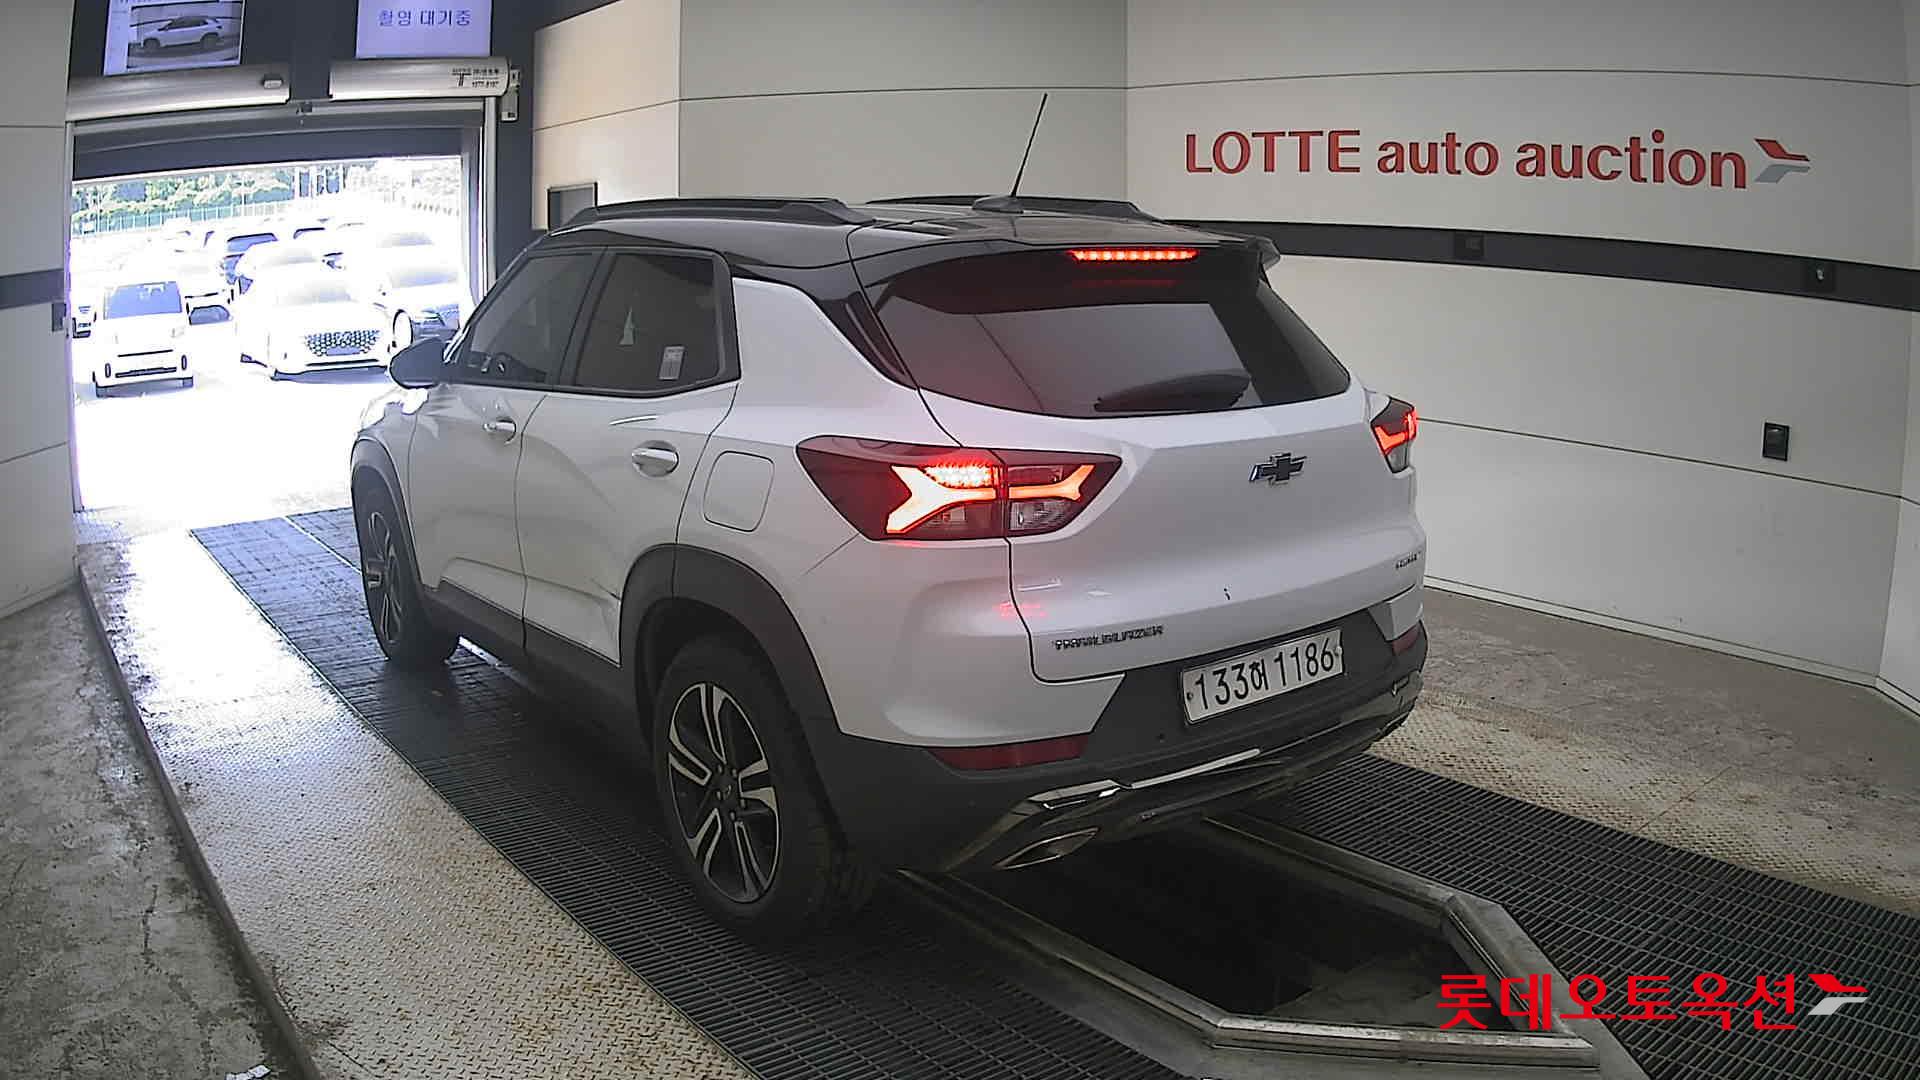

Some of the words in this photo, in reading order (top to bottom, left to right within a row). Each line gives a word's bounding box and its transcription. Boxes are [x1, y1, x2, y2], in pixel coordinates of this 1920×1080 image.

[420, 9, 471, 26] 대기중
[1186, 129, 1361, 174] LOTTE
[1378, 132, 1498, 176] auto
[1516, 129, 1747, 189] auction
[1195, 658, 1269, 710] 133허
[1273, 637, 1335, 686] 1186
